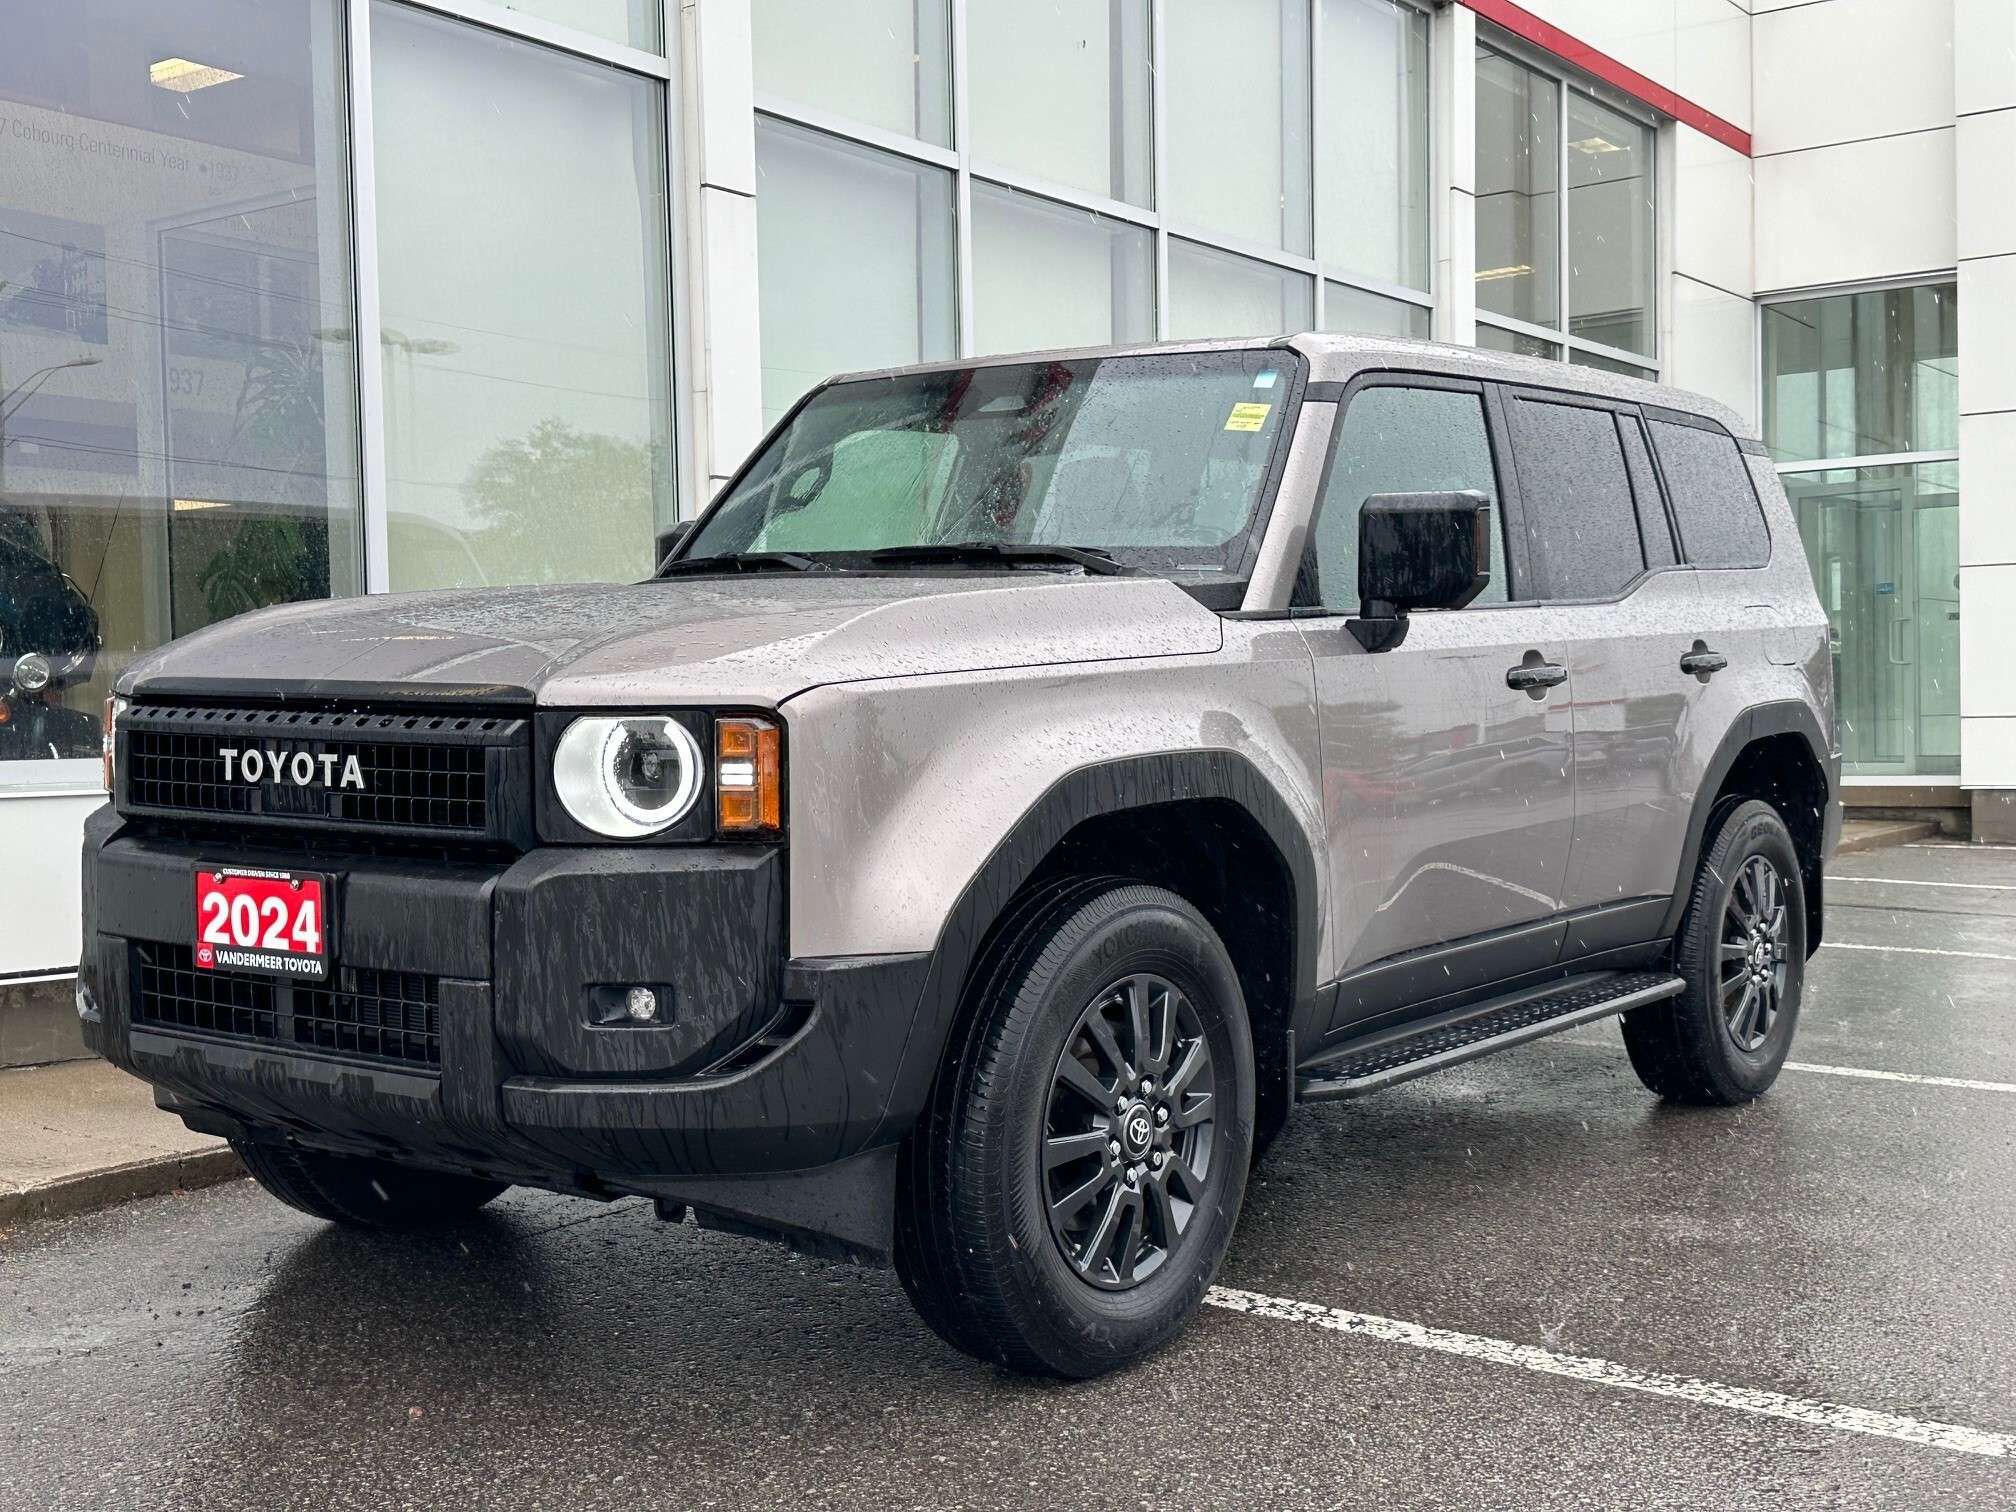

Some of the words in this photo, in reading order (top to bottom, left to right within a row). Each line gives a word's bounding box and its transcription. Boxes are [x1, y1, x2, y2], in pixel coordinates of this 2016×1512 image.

[13, 119, 74, 150] Cobourg
[79, 132, 157, 163] Centennial
[160, 149, 190, 171] Year
[219, 748, 365, 789] TOYOTA
[203, 891, 320, 953] 2024
[216, 950, 282, 970] VANDERMEER
[284, 957, 323, 975] TOYOTA
